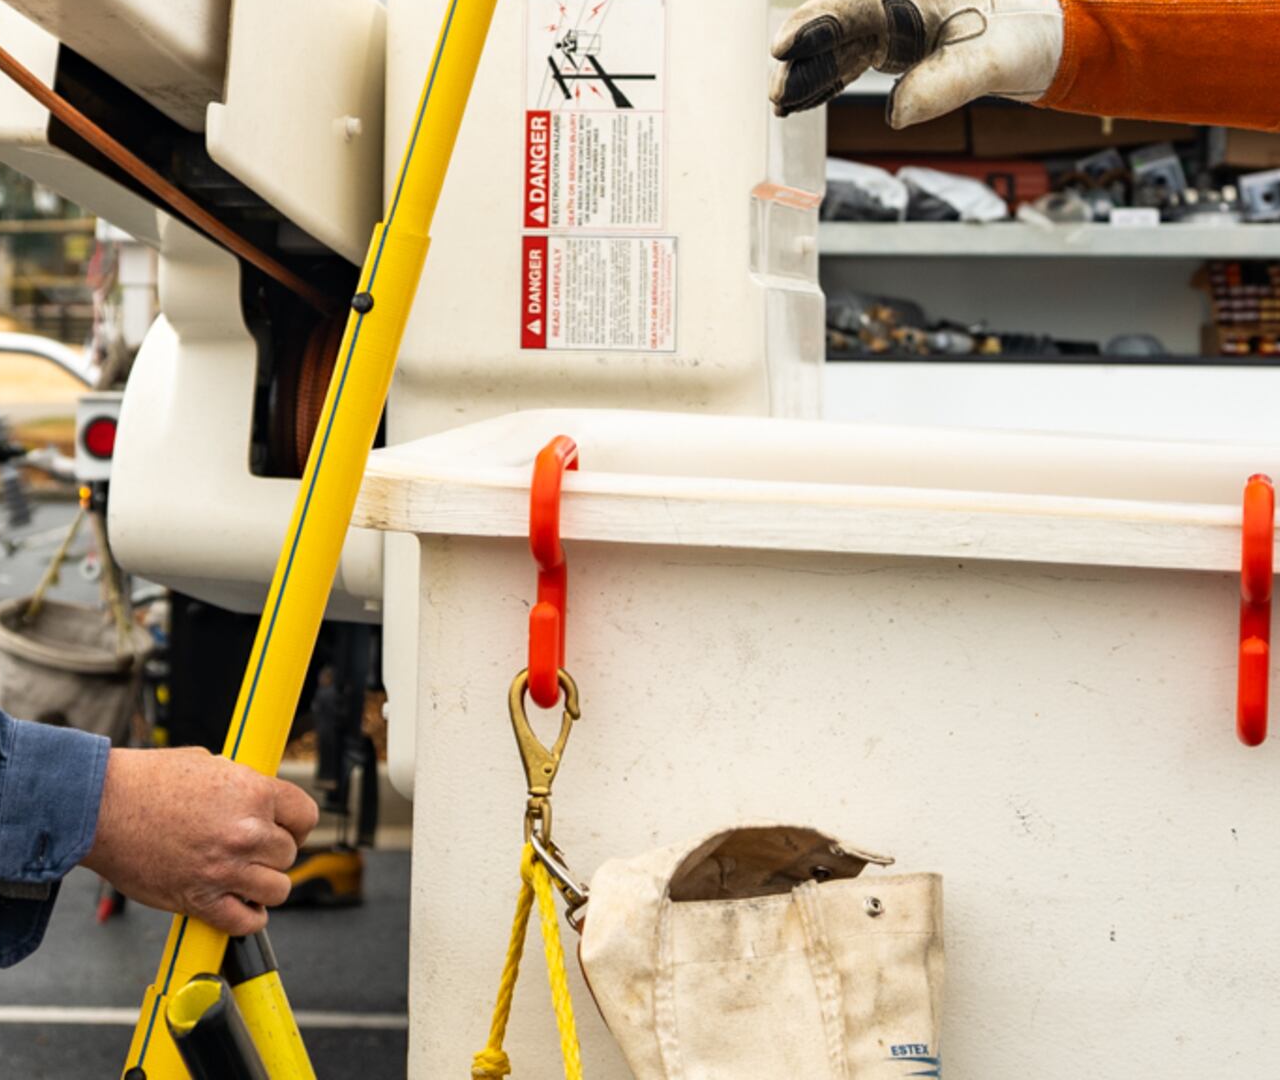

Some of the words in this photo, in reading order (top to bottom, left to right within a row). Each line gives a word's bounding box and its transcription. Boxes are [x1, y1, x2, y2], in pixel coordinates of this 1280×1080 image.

[529, 116, 547, 203] DANGER
[528, 248, 542, 314] DANGER
[553, 248, 561, 306] CAREFULLY
[552, 310, 560, 337] READ
[891, 1044, 929, 1056] ESTEX
